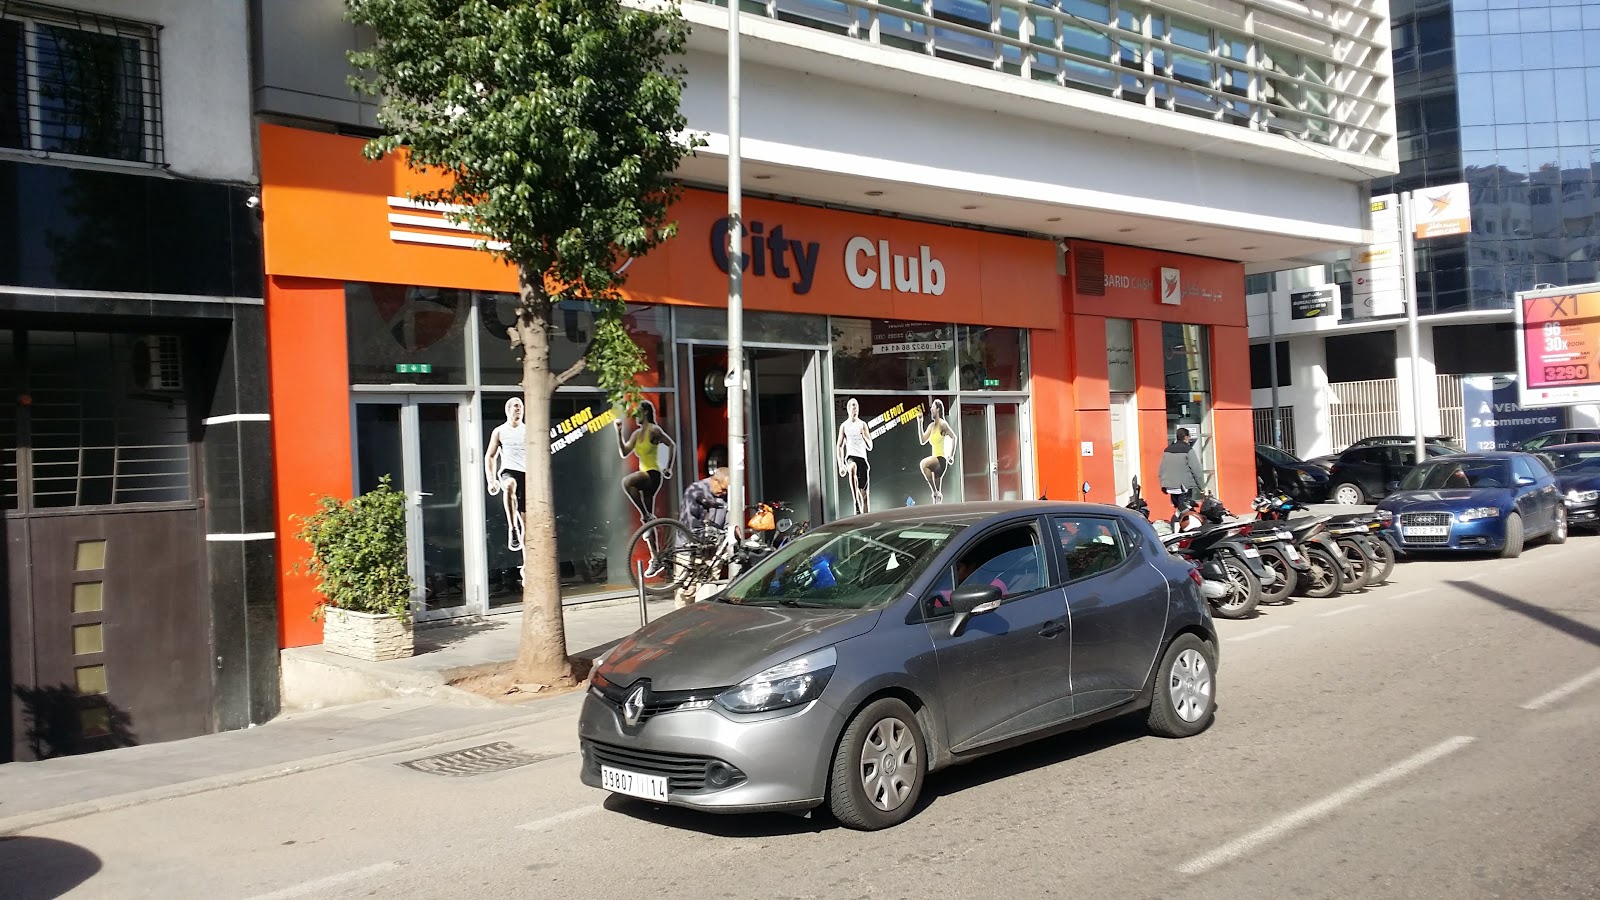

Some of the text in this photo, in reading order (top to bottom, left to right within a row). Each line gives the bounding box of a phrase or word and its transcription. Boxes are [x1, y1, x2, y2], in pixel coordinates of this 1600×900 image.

[710, 217, 946, 297] City Club
[1104, 274, 1153, 290] BARID CASH
[1544, 321, 1561, 336] 96
[1545, 365, 1588, 381] 3290
[561, 419, 573, 434] LE
[570, 407, 593, 428] FOOT
[884, 411, 891, 422] LE
[890, 403, 904, 418] FOOT
[901, 405, 923, 425] FITNESS
[1472, 416, 1557, 428] 2 commerces
[1478, 441, 1495, 450] 123
[1409, 527, 1427, 535] 3212
[603, 769, 633, 792] 39807
[651, 778, 665, 798] 14
